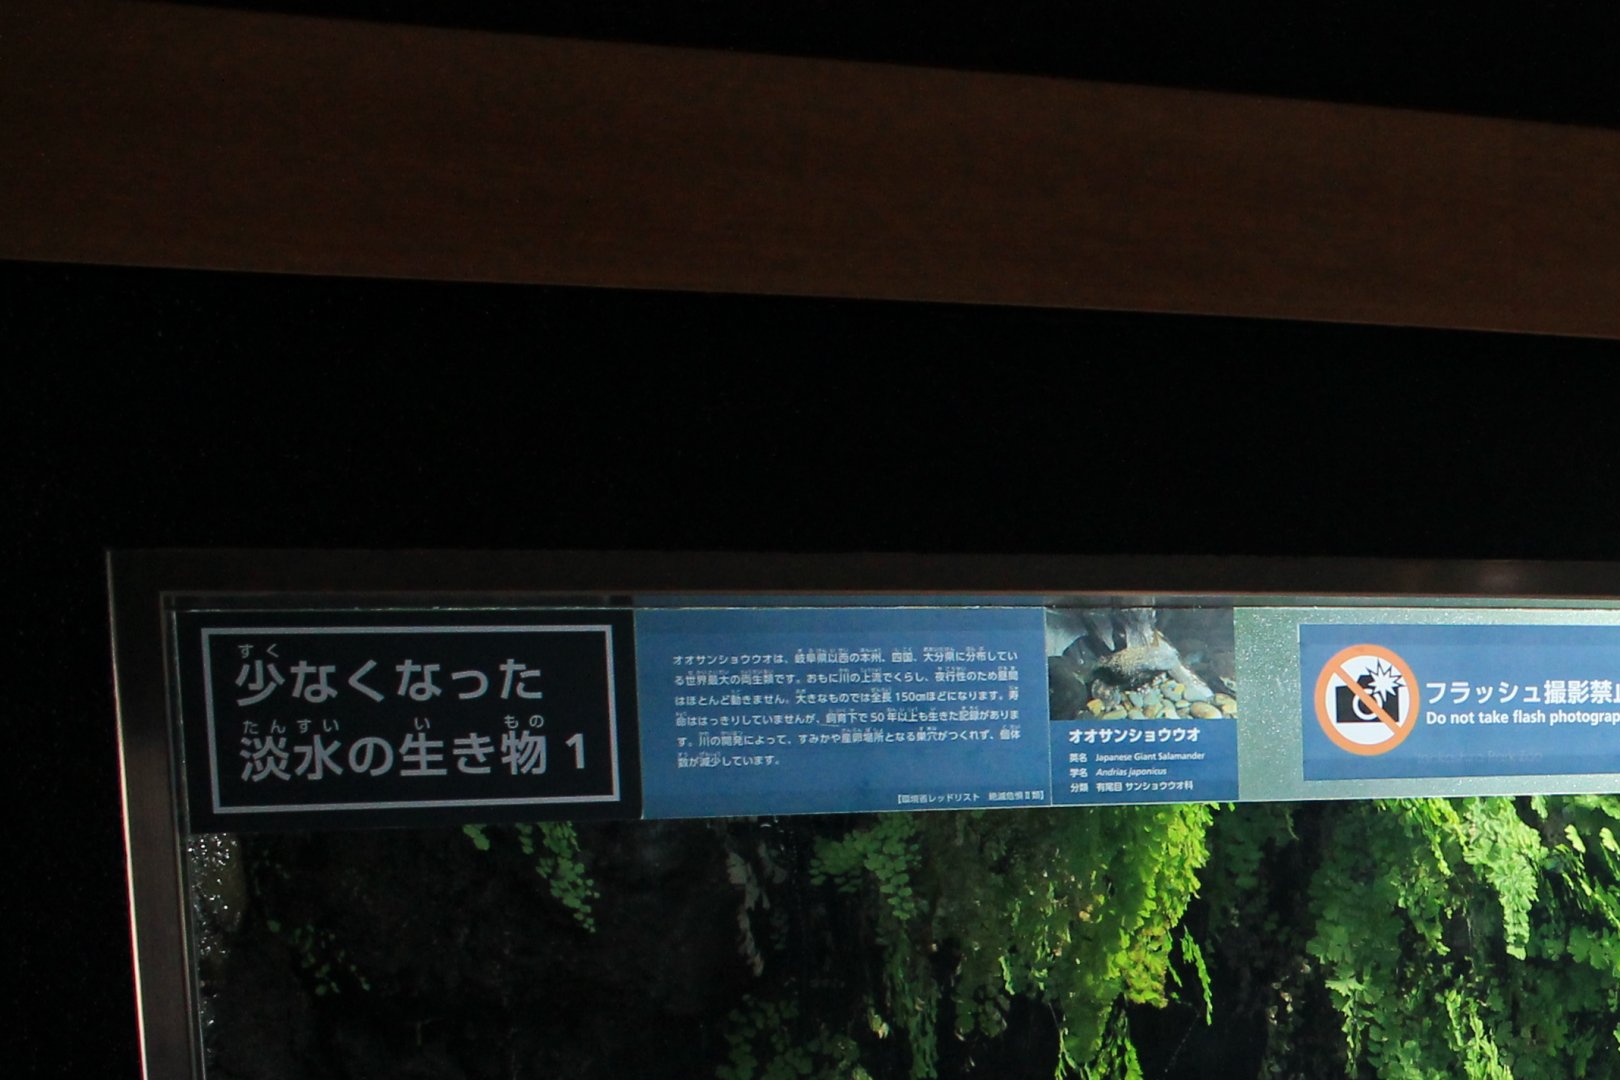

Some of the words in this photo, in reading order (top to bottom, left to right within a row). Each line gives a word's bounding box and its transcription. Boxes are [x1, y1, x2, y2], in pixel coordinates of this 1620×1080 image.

[238, 643, 280, 659] すく
[234, 658, 544, 707] 少なくなった
[414, 716, 431, 731] い
[503, 713, 545, 729] もの
[1426, 711, 1448, 725] Do
[1450, 711, 1475, 724] not
[1478, 709, 1509, 724] take
[1512, 709, 1546, 724] flash
[242, 718, 340, 735] たんすい
[1069, 727, 1201, 744] オオサンショウウオ
[239, 730, 548, 783] 淡水の生き物
[565, 733, 586, 770] 1
[1069, 753, 1088, 763] 英名
[1095, 753, 1132, 763] Japanese
[1133, 752, 1156, 761] Giant
[1158, 752, 1206, 761] Salamander
[1069, 768, 1088, 778] 学名
[1095, 768, 1127, 777] Andrias
[1128, 767, 1167, 778] japonicus
[1070, 783, 1089, 793] 分類
[1125, 780, 1194, 791] サンショウウオ科
